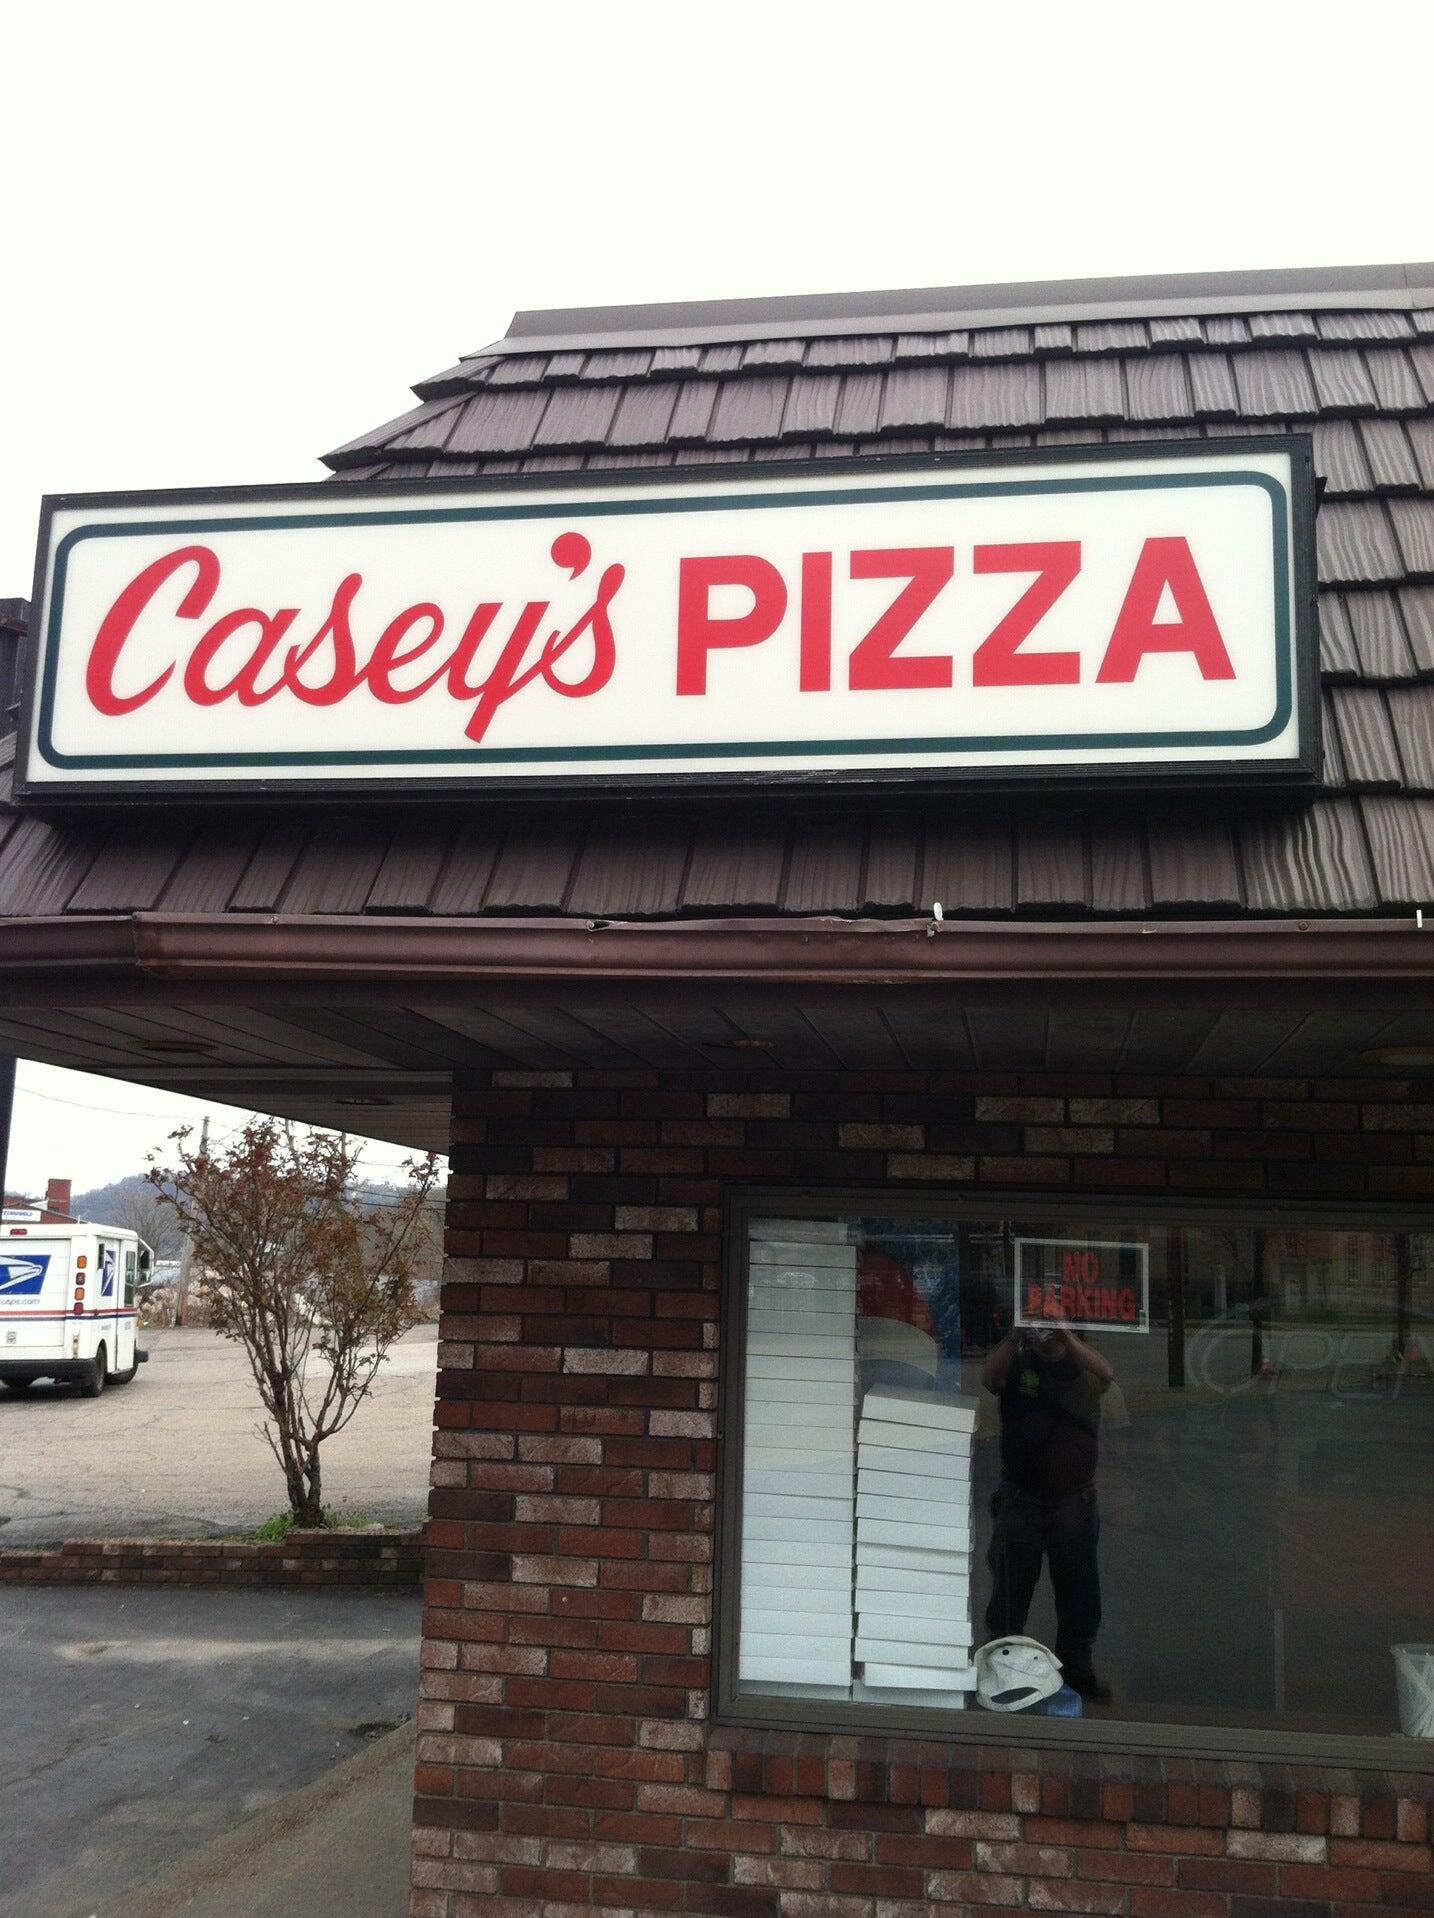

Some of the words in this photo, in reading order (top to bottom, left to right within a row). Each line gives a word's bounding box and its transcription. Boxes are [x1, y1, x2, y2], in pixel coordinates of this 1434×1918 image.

[85, 532, 625, 742] Casey's
[676, 536, 1236, 697] PIZZA
[1063, 1250, 1100, 1285] NO
[1025, 1283, 1137, 1321] PARKING
